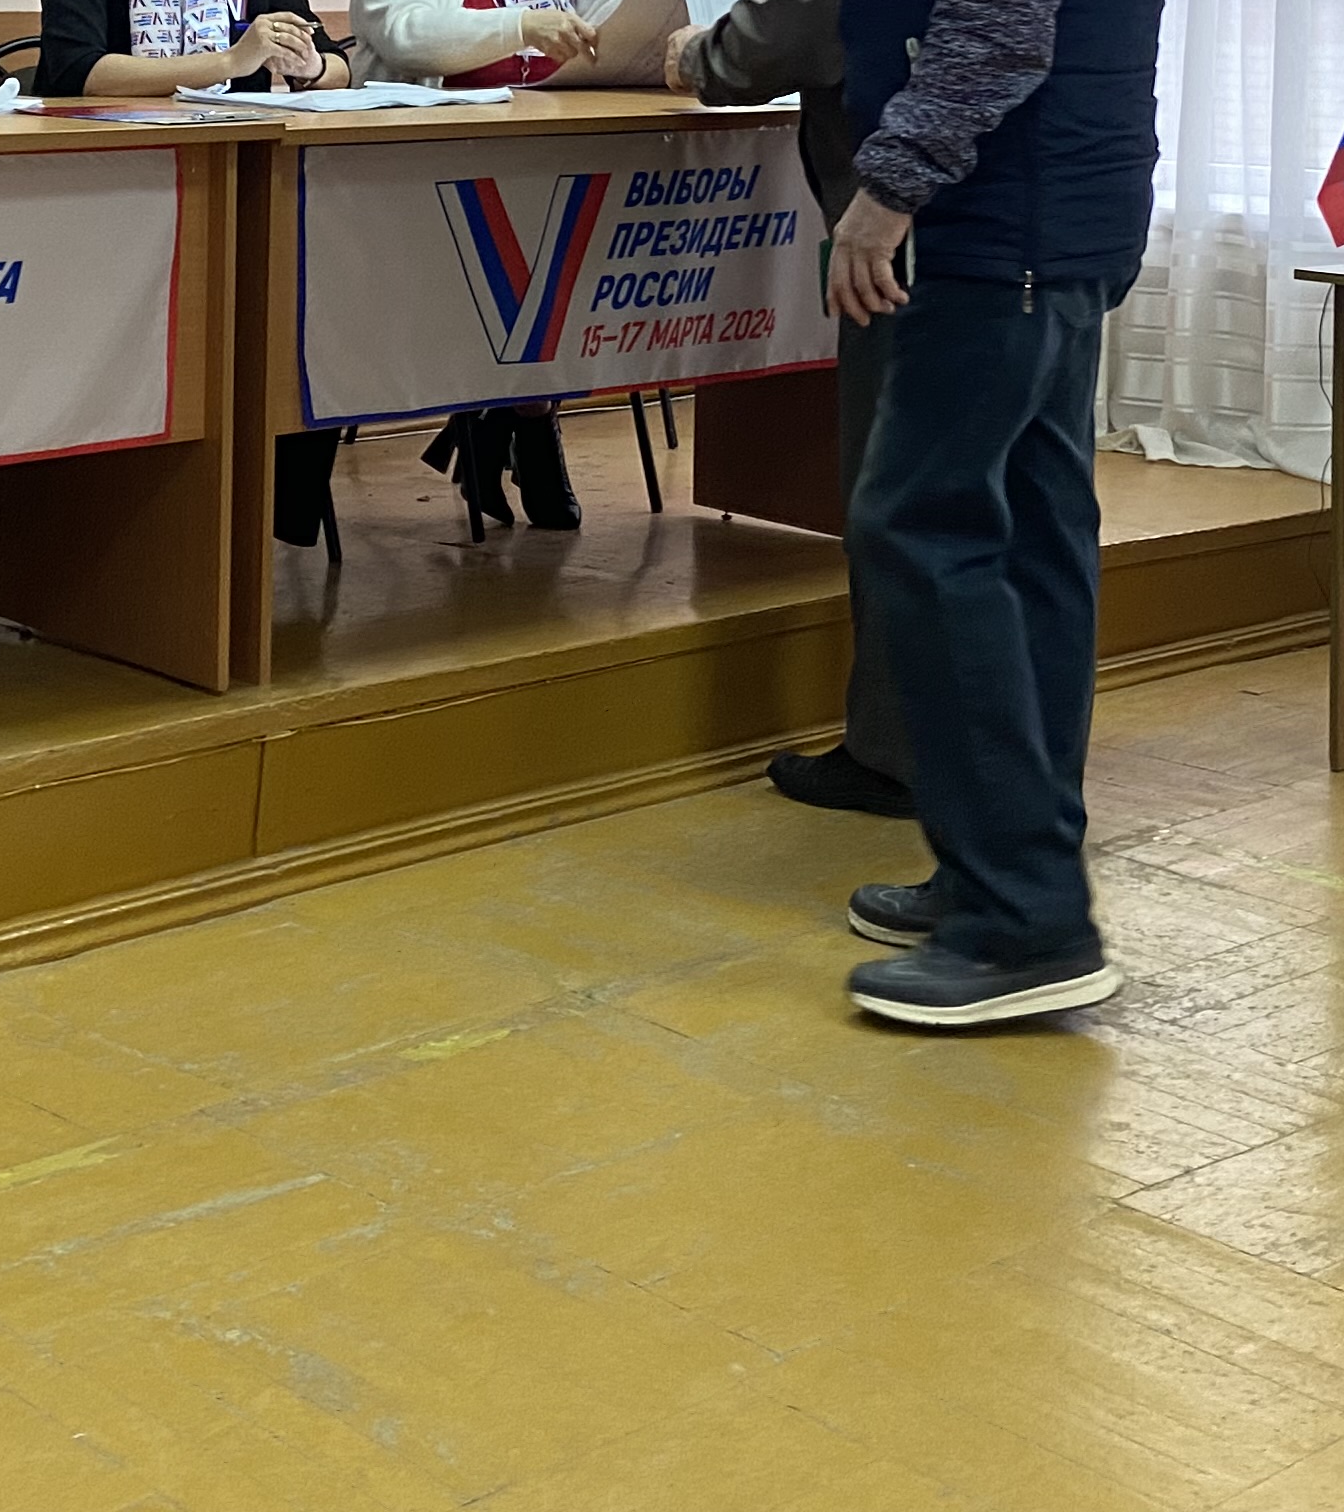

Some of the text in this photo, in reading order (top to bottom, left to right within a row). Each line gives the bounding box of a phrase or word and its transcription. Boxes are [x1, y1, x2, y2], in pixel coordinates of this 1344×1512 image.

[623, 165, 760, 208] ВЫБОРЫ
[607, 210, 797, 260] ПРЕЗИДЕНТА
[590, 266, 715, 312] РОССИИ
[646, 316, 714, 352] МАРТА
[718, 308, 776, 343] 2024
